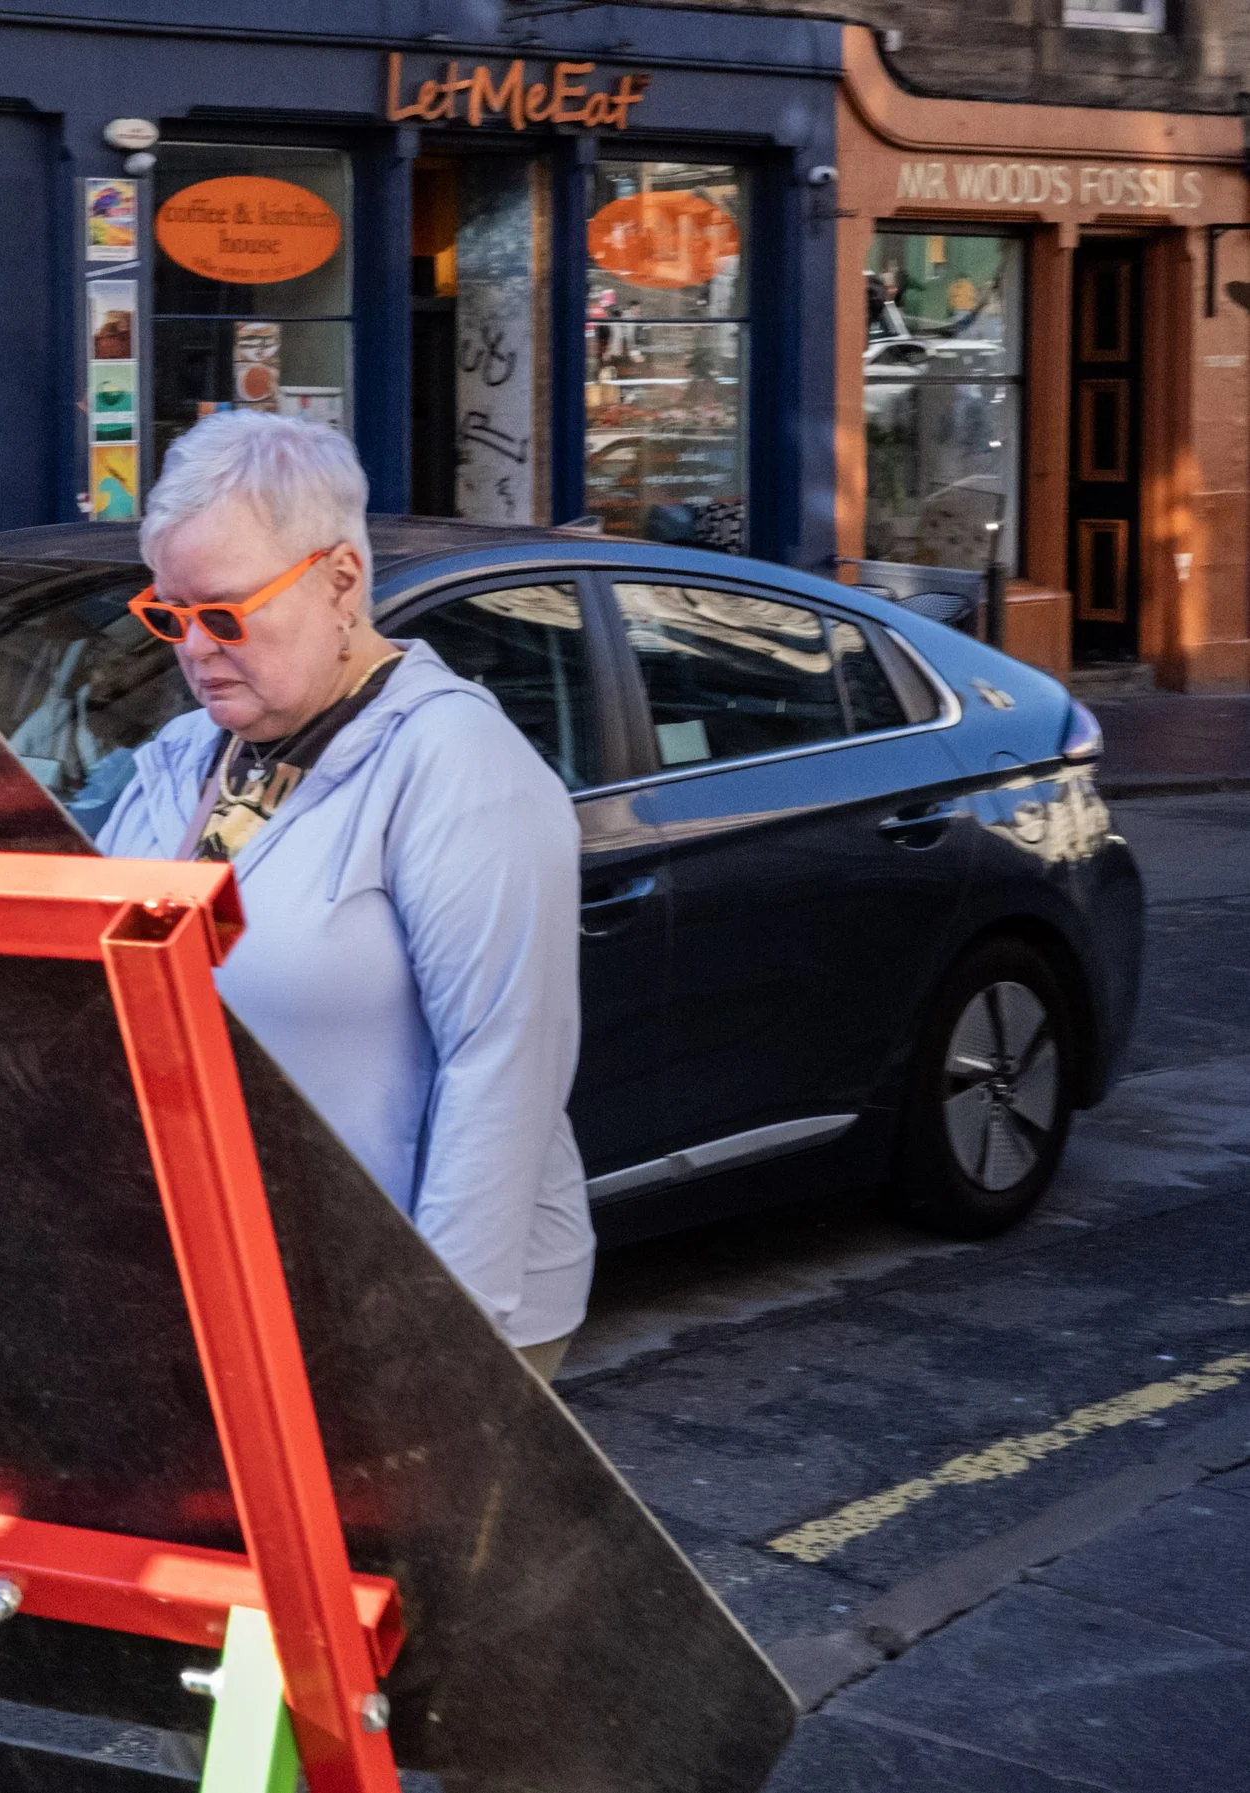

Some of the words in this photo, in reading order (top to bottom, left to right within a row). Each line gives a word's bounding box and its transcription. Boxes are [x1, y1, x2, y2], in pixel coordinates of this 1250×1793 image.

[896, 162, 948, 199] MR
[1079, 167, 1204, 209] FOSSILS
[162, 199, 230, 224] coffee
[232, 202, 254, 225] &
[217, 229, 282, 254] house
